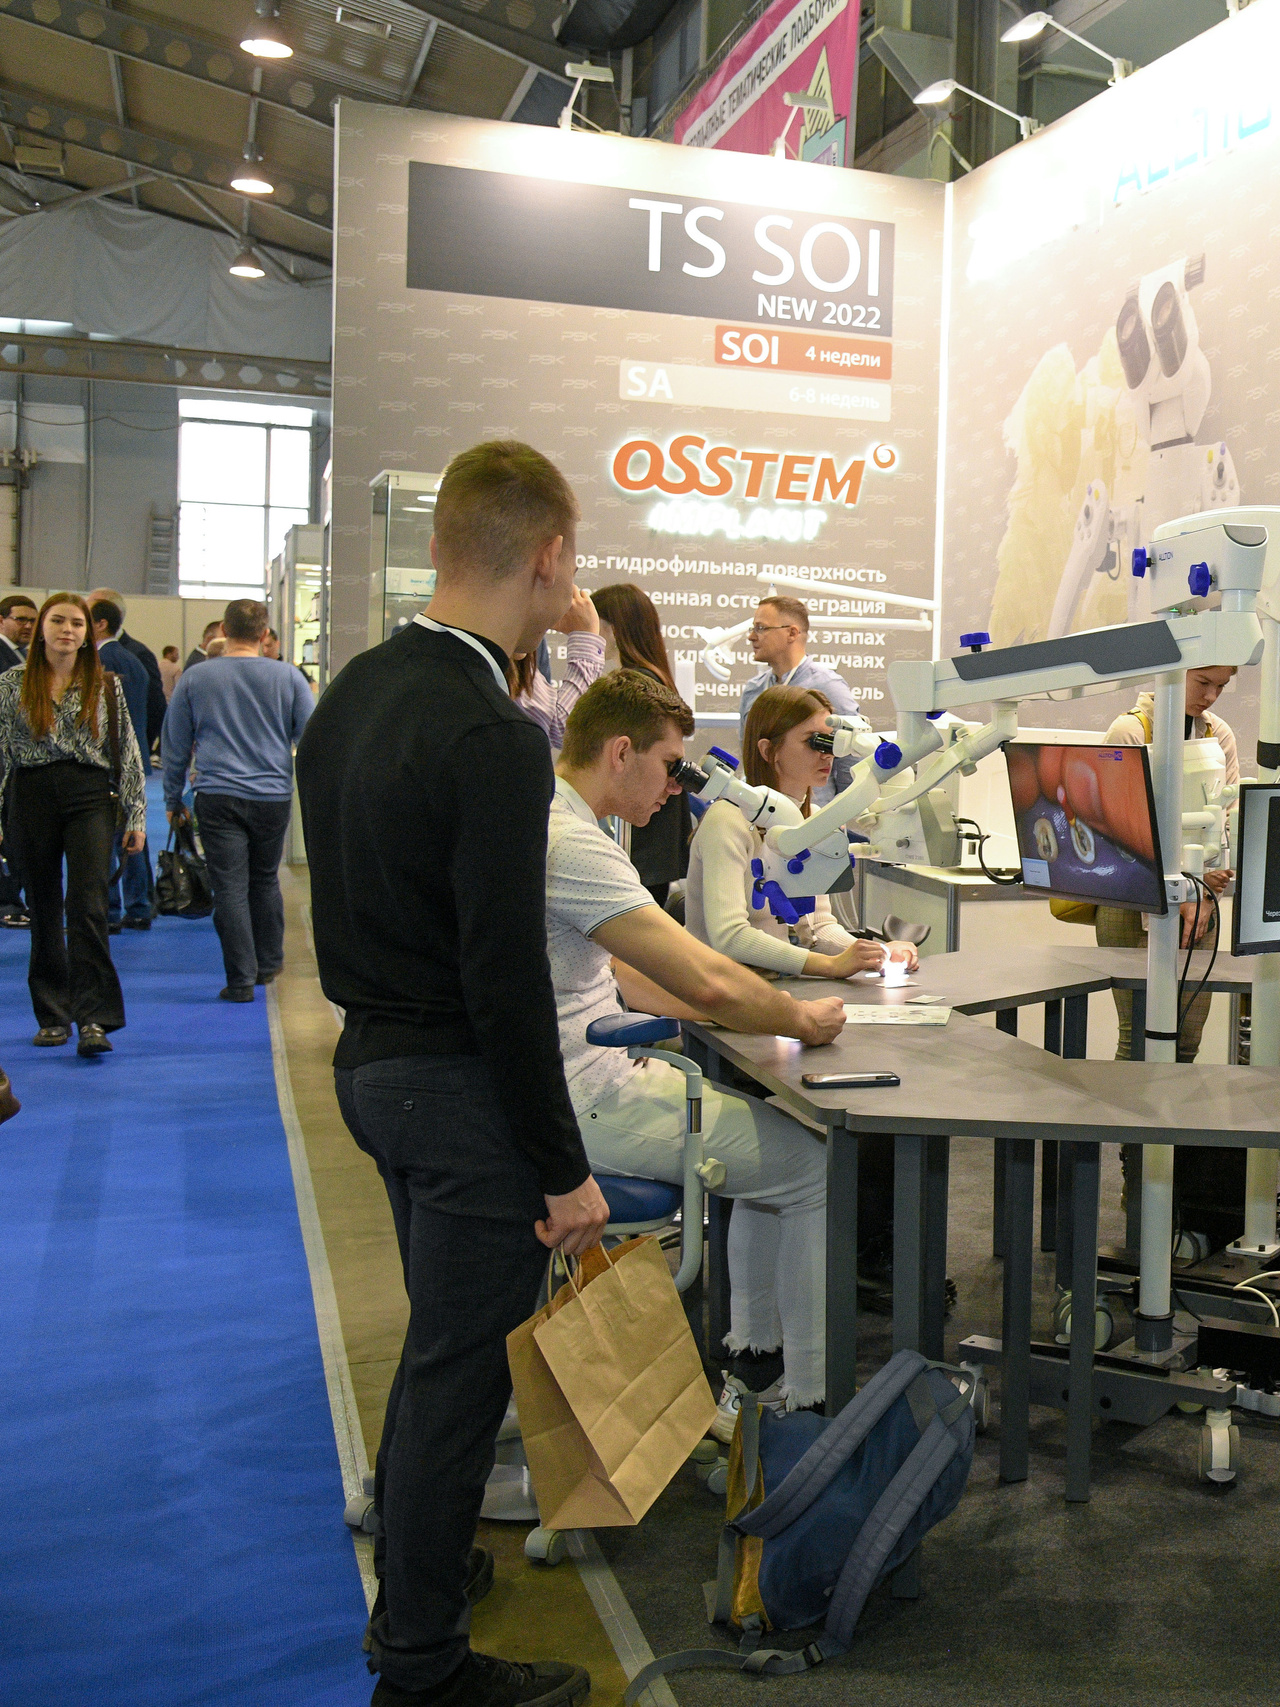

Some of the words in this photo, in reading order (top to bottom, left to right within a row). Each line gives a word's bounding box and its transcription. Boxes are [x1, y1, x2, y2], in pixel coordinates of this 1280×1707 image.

[728, 32, 788, 118] ТЕМАТИЧЕСКИЕ
[628, 197, 727, 279] TS
[752, 214, 880, 297] SOI
[757, 293, 817, 322] NEW
[821, 301, 882, 330] 2022
[721, 330, 779, 365] SOI
[805, 346, 817, 361] 4
[819, 350, 881, 368] недели
[627, 366, 673, 399] SA
[789, 386, 816, 402] 6-8
[819, 391, 881, 411] недель
[612, 435, 866, 505] OSSTEM
[576, 554, 758, 577] а-гидрофильная
[762, 563, 887, 583] поверхность
[822, 630, 886, 645] этапах
